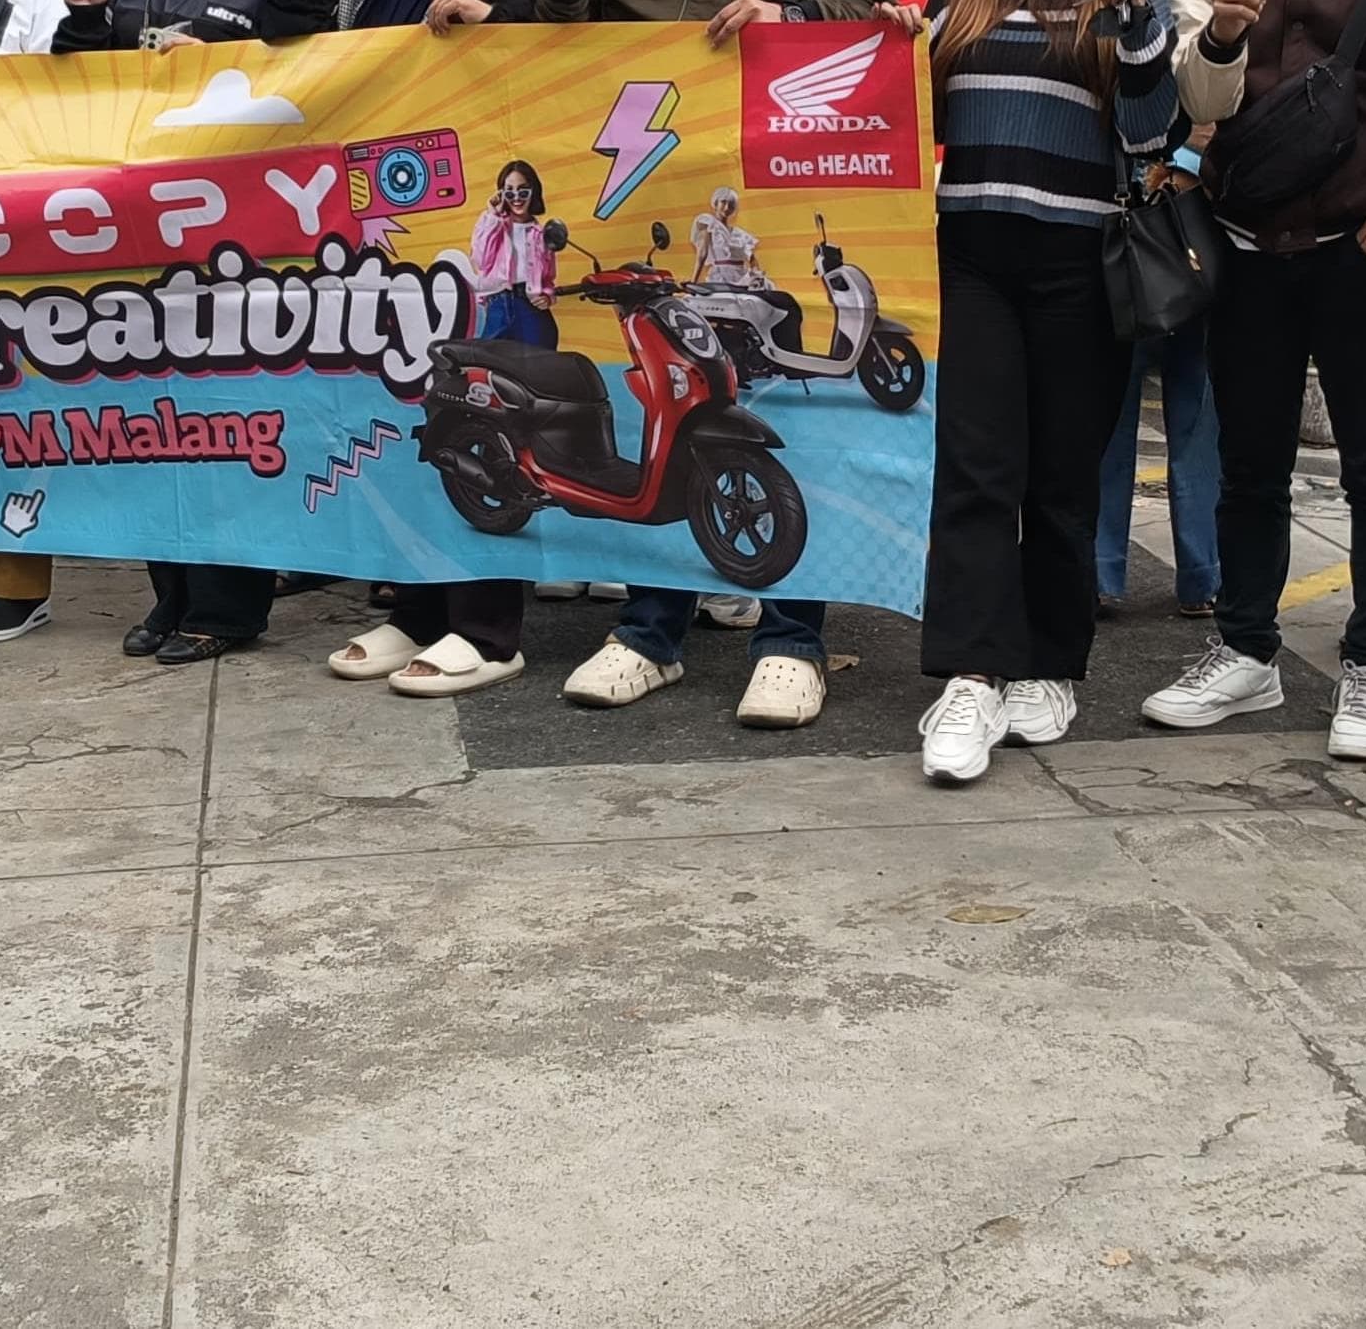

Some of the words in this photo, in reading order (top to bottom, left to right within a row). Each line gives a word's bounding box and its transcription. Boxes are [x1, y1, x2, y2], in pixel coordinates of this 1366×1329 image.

[767, 115, 891, 133] HONDA
[769, 155, 814, 177] One
[818, 154, 894, 177] HEART.
[65, 399, 283, 475] Malang
